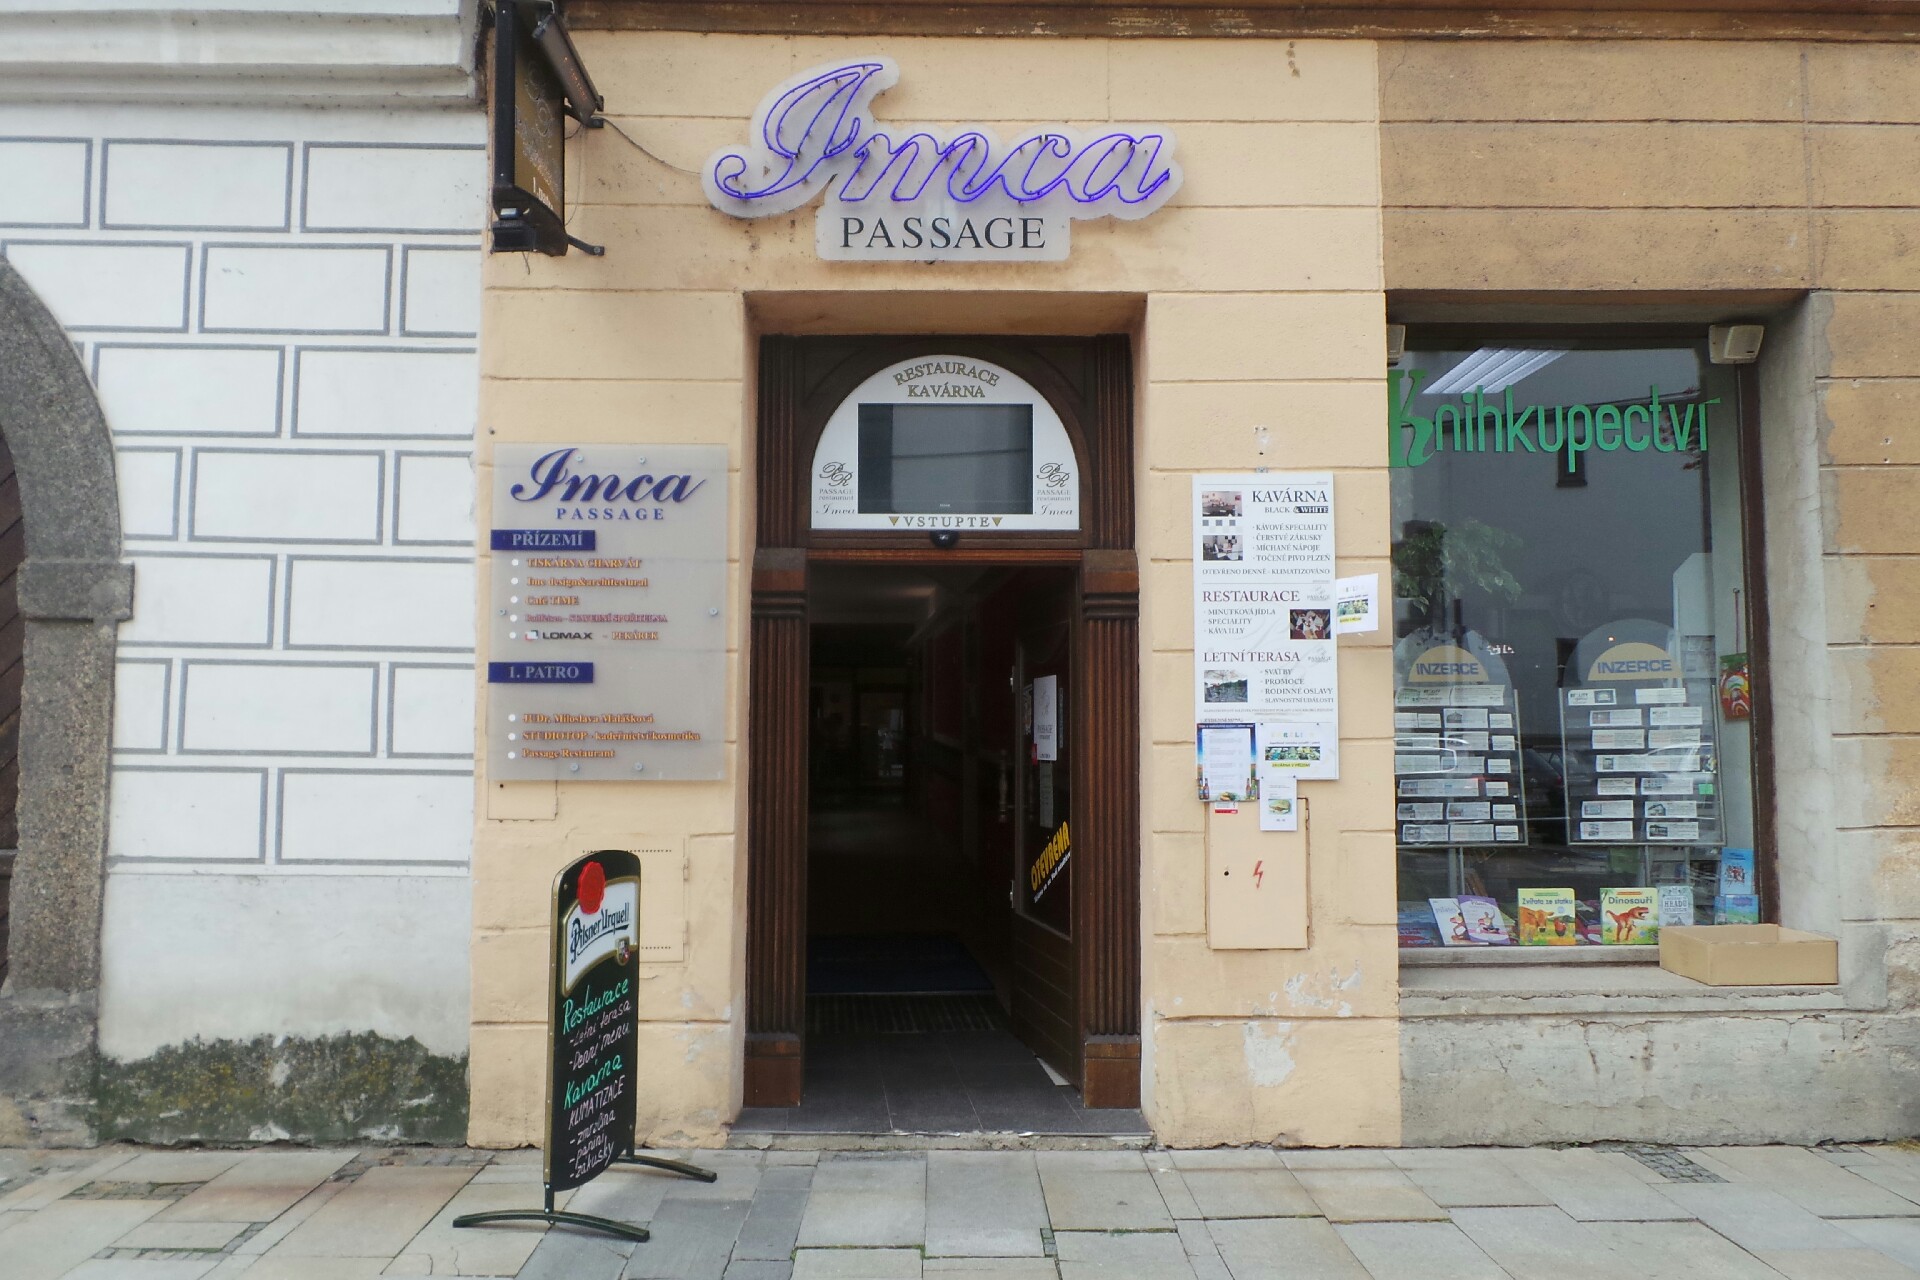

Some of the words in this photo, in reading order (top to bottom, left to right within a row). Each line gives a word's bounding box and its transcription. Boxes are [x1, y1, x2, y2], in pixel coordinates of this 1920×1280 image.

[839, 216, 1047, 250] PASSAGE
[892, 361, 1000, 387] RESTAURACE
[907, 382, 986, 398] KAVÁRNA
[510, 447, 706, 503] Imca
[1252, 487, 1328, 503] KAVÁRNA
[555, 508, 665, 520] PASSAGE
[1264, 506, 1290, 514] BLACK
[1301, 506, 1328, 514] WHITE
[903, 516, 990, 528] VSTUPTE
[1255, 522, 1285, 531] KÁVOVÉ
[1285, 523, 1328, 531] SPECIALITY
[511, 530, 583, 546] PŘÍZEMÍ
[1255, 532, 1288, 541] ČERSTVÉ
[1289, 533, 1322, 541] ZÁKUSKY
[1256, 542, 1291, 551] MÍCHANÉ
[1292, 543, 1320, 552] NÁPOJE
[1256, 552, 1287, 562] TOČENÉ
[1287, 554, 1306, 562] PIVO
[1202, 567, 1241, 575] OTEVŘENO
[1242, 567, 1267, 575] DENNĚ
[1271, 566, 1331, 575] KLIMATIZOVÁNO
[1202, 590, 1300, 602] RESTAURACE
[1208, 606, 1254, 616] MINUTKOVÁ
[1254, 606, 1276, 616] JÍDLA
[1208, 617, 1252, 625] SPECIALITY
[542, 632, 593, 640] LOMAX
[1208, 626, 1228, 634] KÁVA
[1203, 649, 1245, 663] LETNÍ
[1247, 651, 1301, 662] TERASA
[1264, 667, 1293, 676] SVATBY
[1416, 662, 1479, 676] INZERCE
[1598, 659, 1672, 673] INZERCE
[509, 666, 521, 679] 1.
[525, 666, 580, 679] PATRO
[1265, 686, 1302, 695] RODINNÉ
[1303, 687, 1333, 695] OSLAVY
[521, 749, 560, 759] Passage
[561, 749, 616, 759] Restaurant
[1608, 896, 1653, 905] Dinosauři
[569, 917, 601, 965] Pilsner
[600, 902, 630, 935] Urquell
[562, 978, 629, 1036] Restaurace
[600, 1000, 632, 1029] terasa
[567, 1074, 626, 1131] KLIMATIZACE
